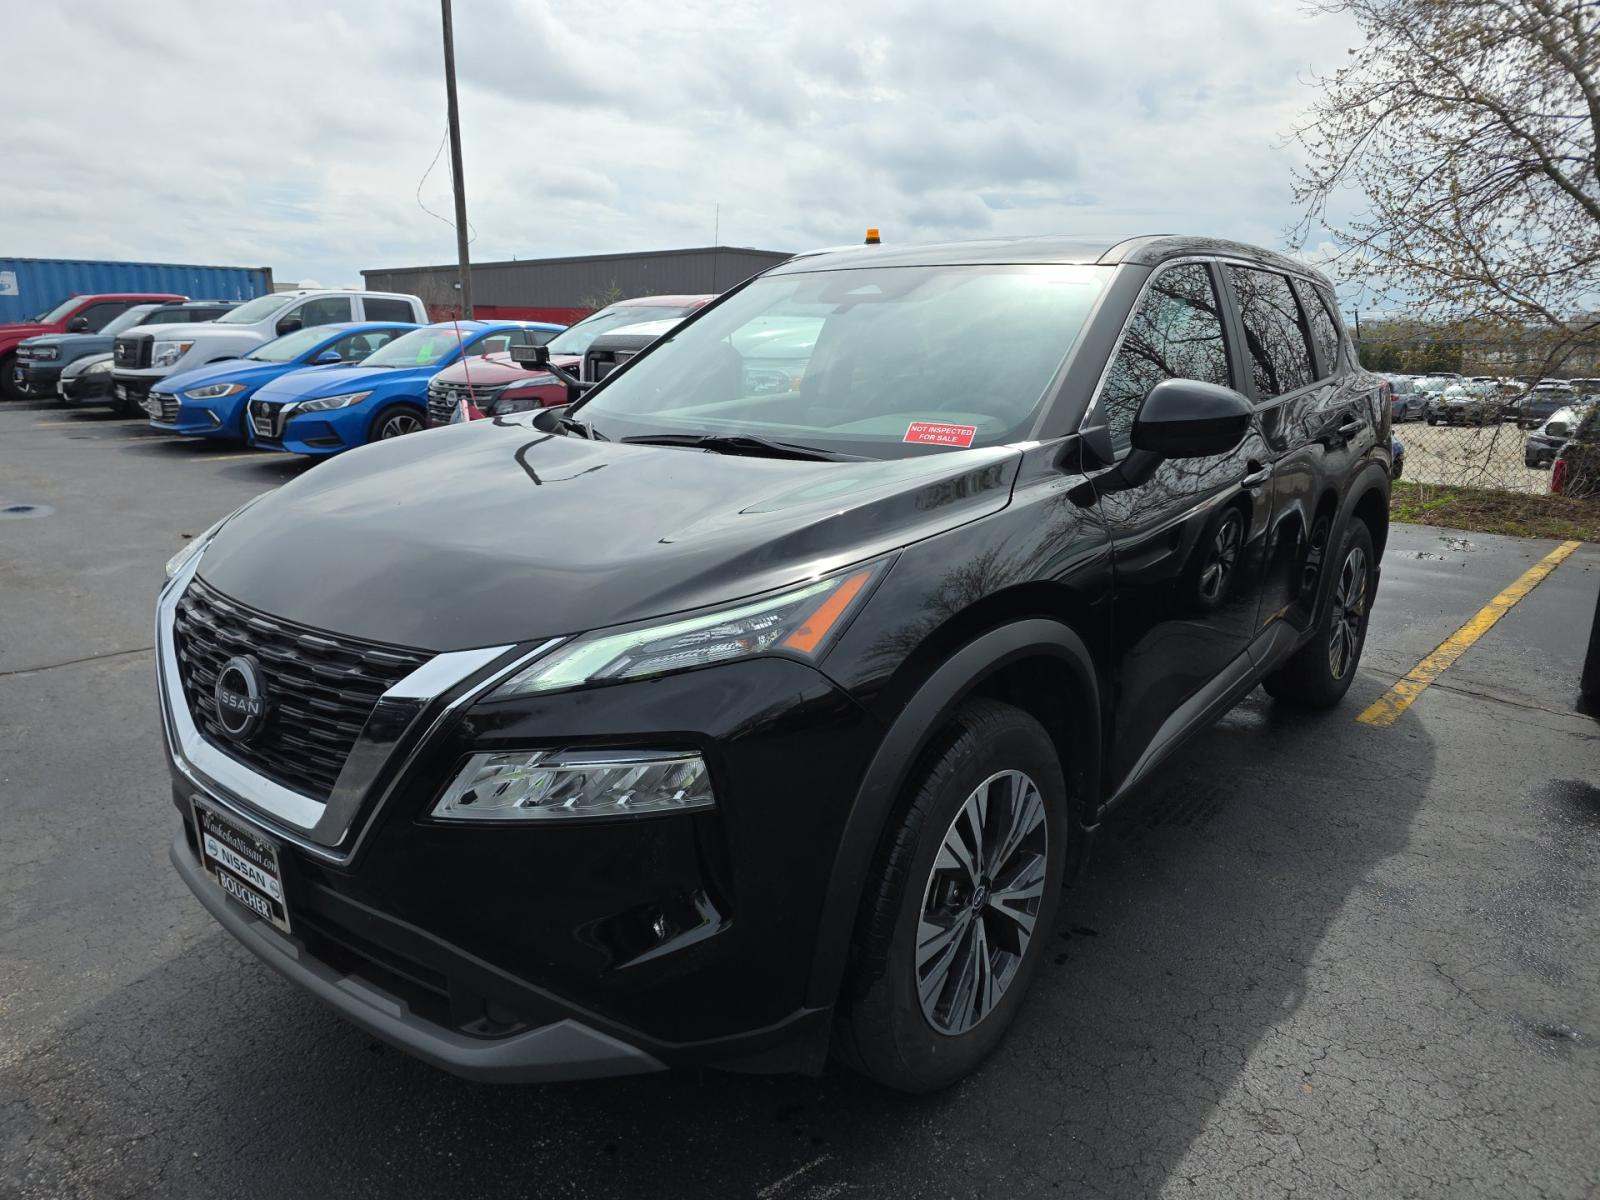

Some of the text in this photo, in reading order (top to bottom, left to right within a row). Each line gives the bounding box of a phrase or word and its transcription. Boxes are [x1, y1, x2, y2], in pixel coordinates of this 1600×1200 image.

[919, 433, 958, 442] FOR SALE
[928, 426, 972, 436] INSPECTED
[221, 848, 267, 888] NISSAN
[220, 872, 270, 918] BOUCHER
